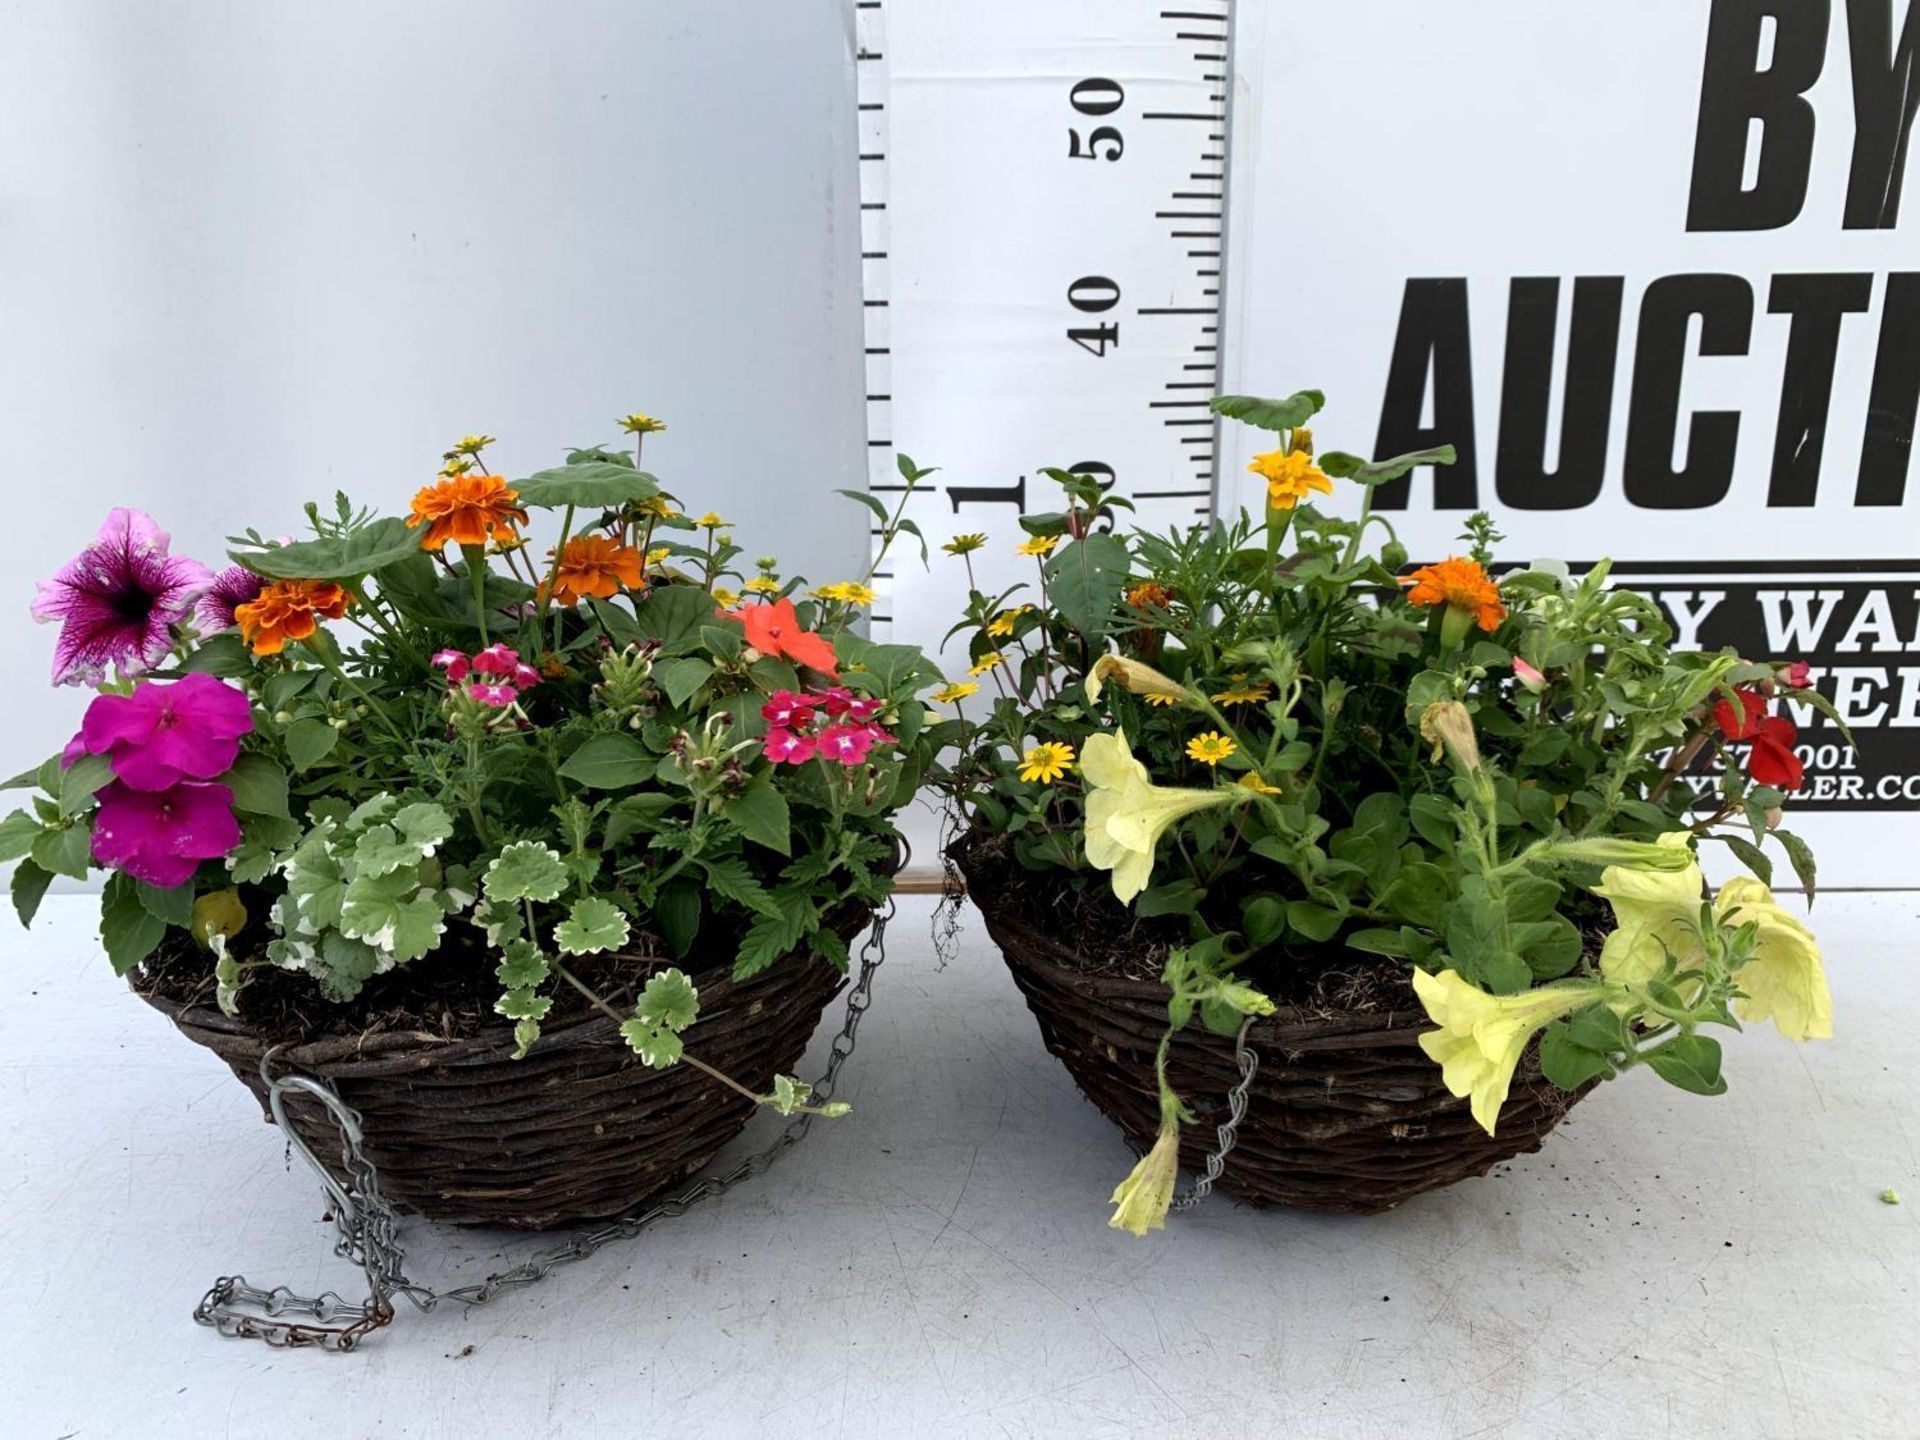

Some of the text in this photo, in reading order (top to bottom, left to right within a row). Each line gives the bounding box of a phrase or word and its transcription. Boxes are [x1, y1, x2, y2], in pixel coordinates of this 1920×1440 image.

[1069, 77, 1125, 161] 50
[1685, 0, 1920, 232] BY
[1067, 275, 1121, 357] 40
